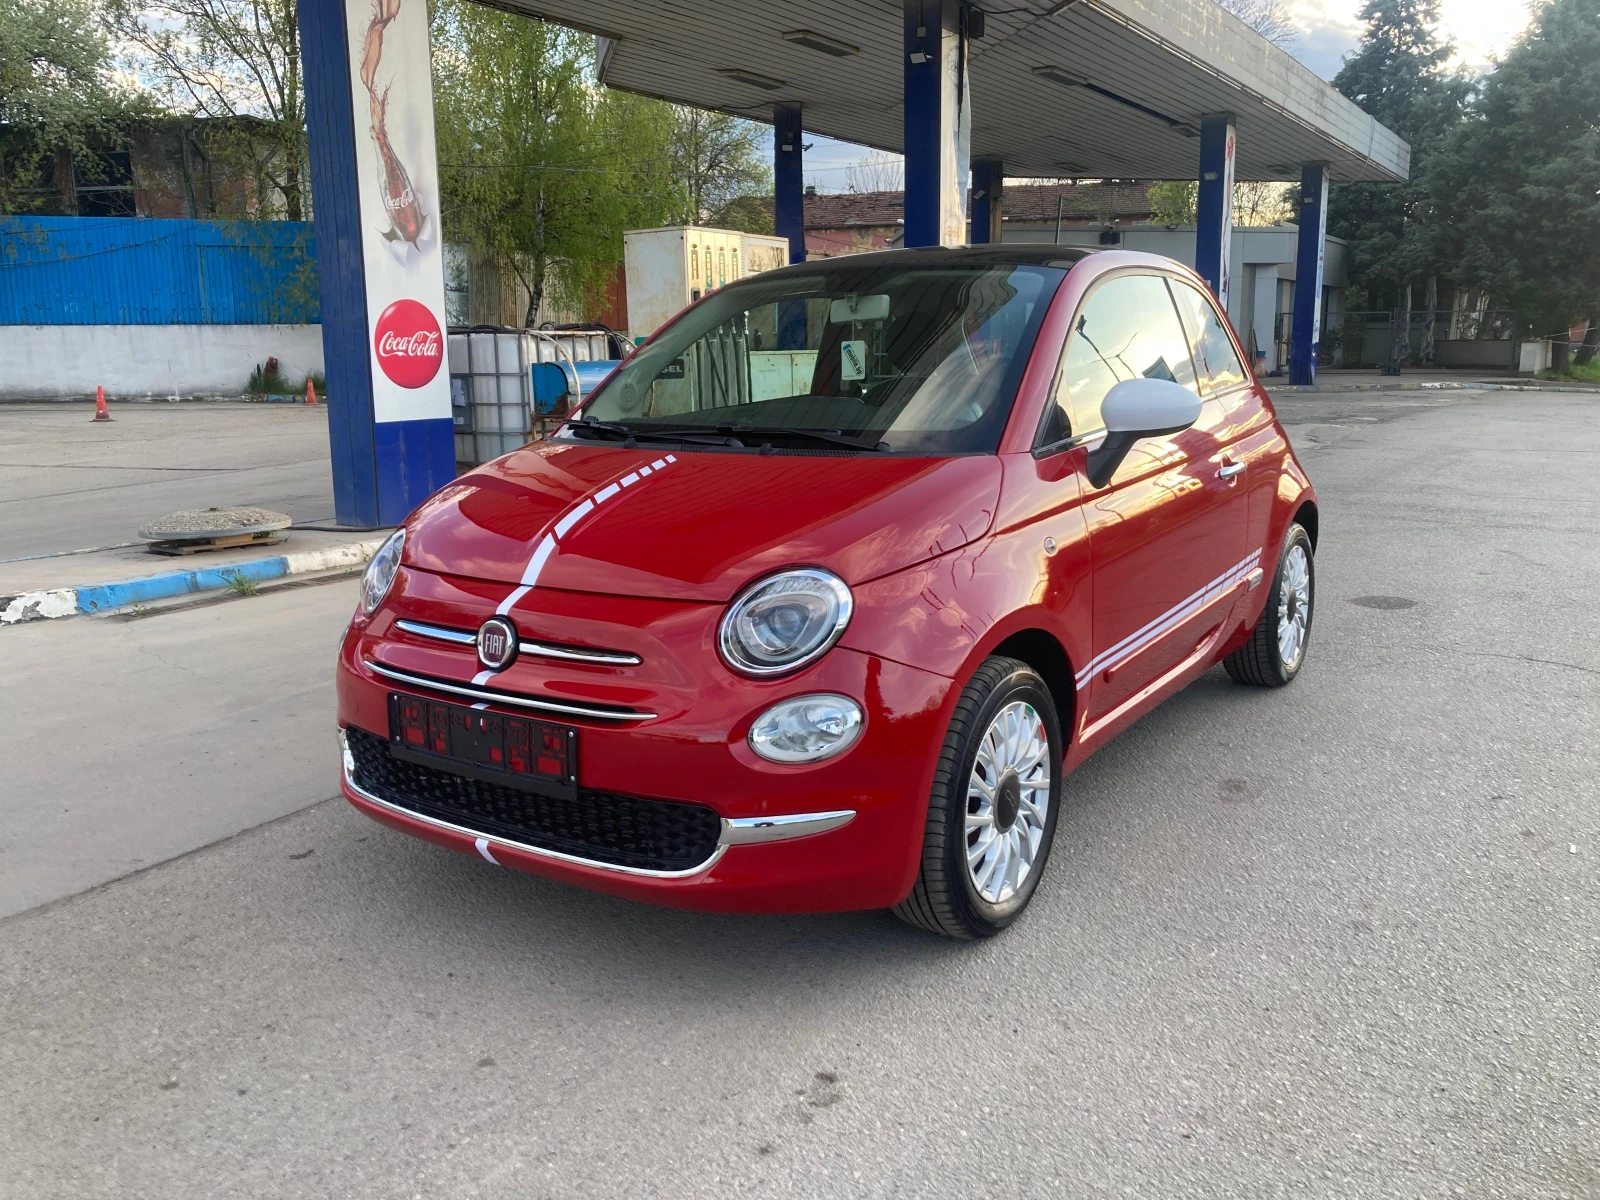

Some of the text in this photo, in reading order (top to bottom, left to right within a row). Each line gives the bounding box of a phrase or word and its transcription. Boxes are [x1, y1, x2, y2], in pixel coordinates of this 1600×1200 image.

[379, 331, 440, 357] Coca-Cola
[846, 348, 863, 375] mobile.bg
[485, 633, 505, 655] FIAT
